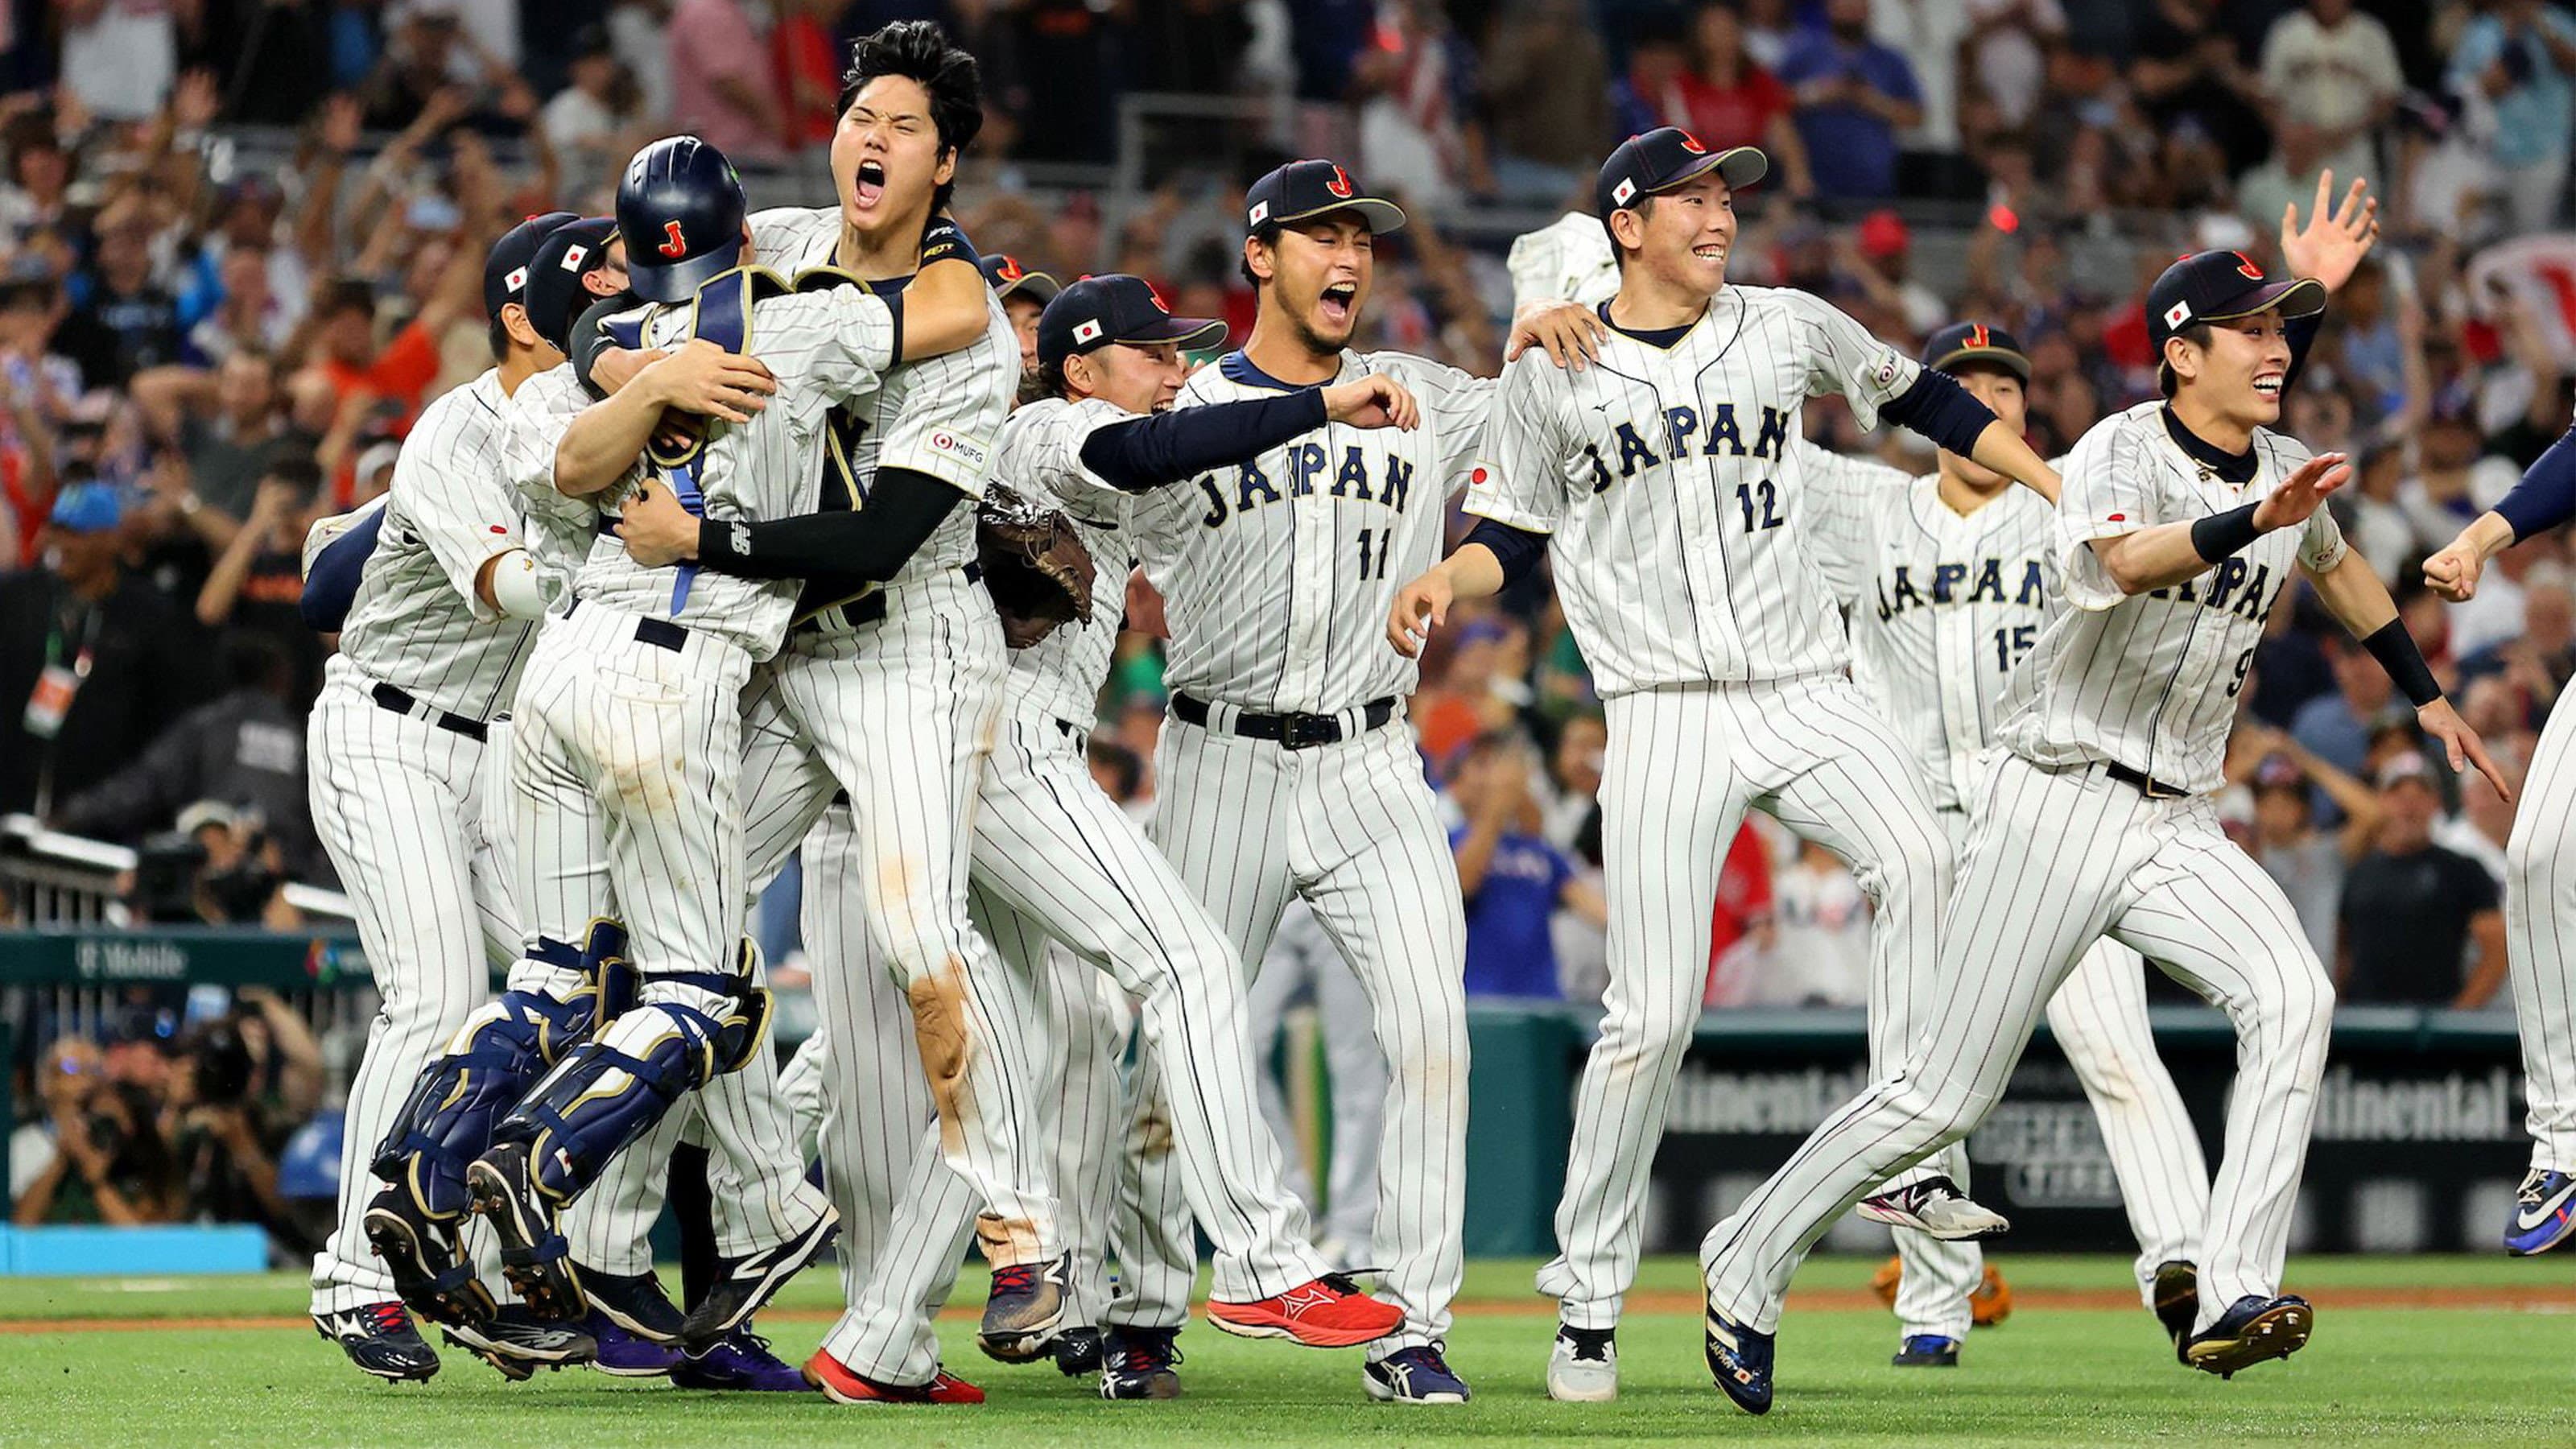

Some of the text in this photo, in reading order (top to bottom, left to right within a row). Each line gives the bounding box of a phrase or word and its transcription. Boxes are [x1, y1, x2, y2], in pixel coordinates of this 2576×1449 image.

[1326, 165, 1353, 199] J
[658, 219, 687, 258] J
[997, 254, 1024, 282] J
[2232, 250, 2265, 280] J
[1962, 323, 1990, 350] J
[953, 441, 984, 464] MUFG
[1584, 402, 1789, 494] JAPAN
[1199, 442, 1414, 529] JAPAN
[1736, 478, 1785, 533] 12
[1356, 527, 1392, 581] 11
